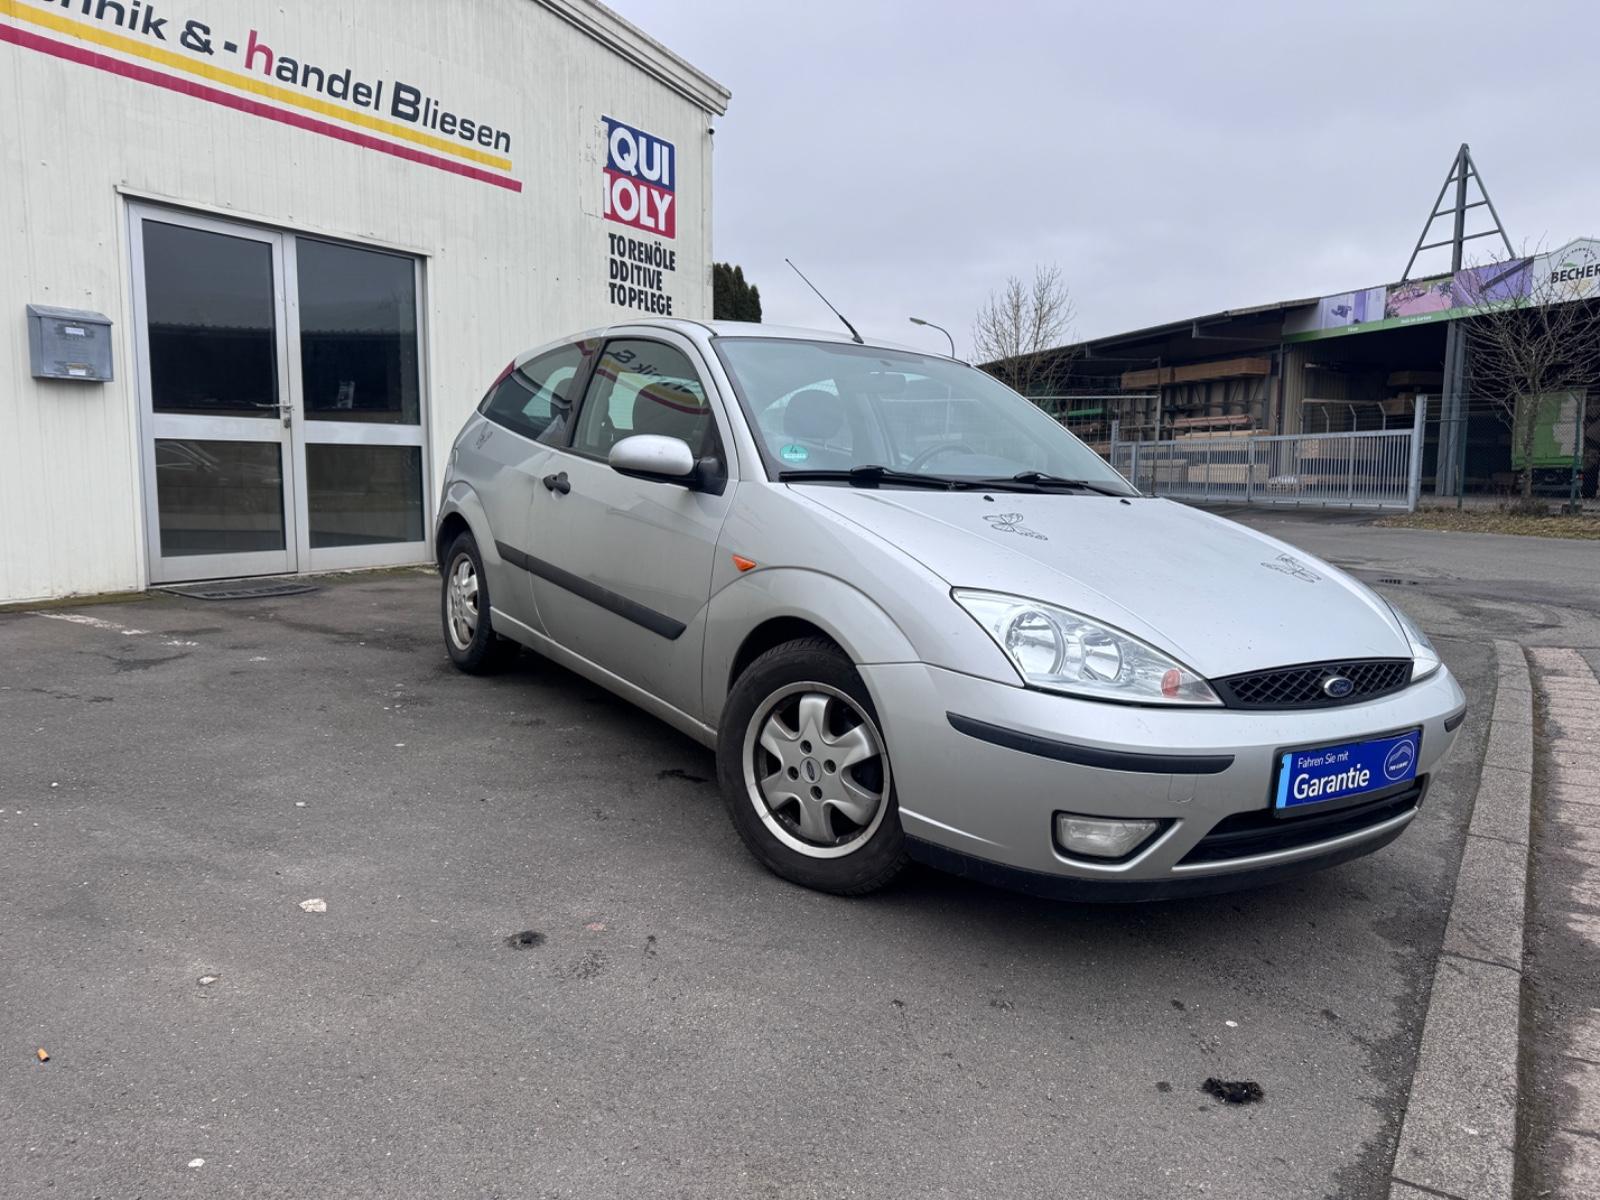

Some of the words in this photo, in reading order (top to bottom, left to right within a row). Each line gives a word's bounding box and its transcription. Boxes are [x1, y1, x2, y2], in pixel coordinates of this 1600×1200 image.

[42, 0, 169, 41] nik
[179, 19, 215, 56] &
[391, 81, 511, 152] Bliesen
[1298, 754, 1324, 769] Fahren
[1325, 752, 1337, 764] Sie
[1337, 750, 1349, 762] mit
[1294, 764, 1370, 799] Garantie
